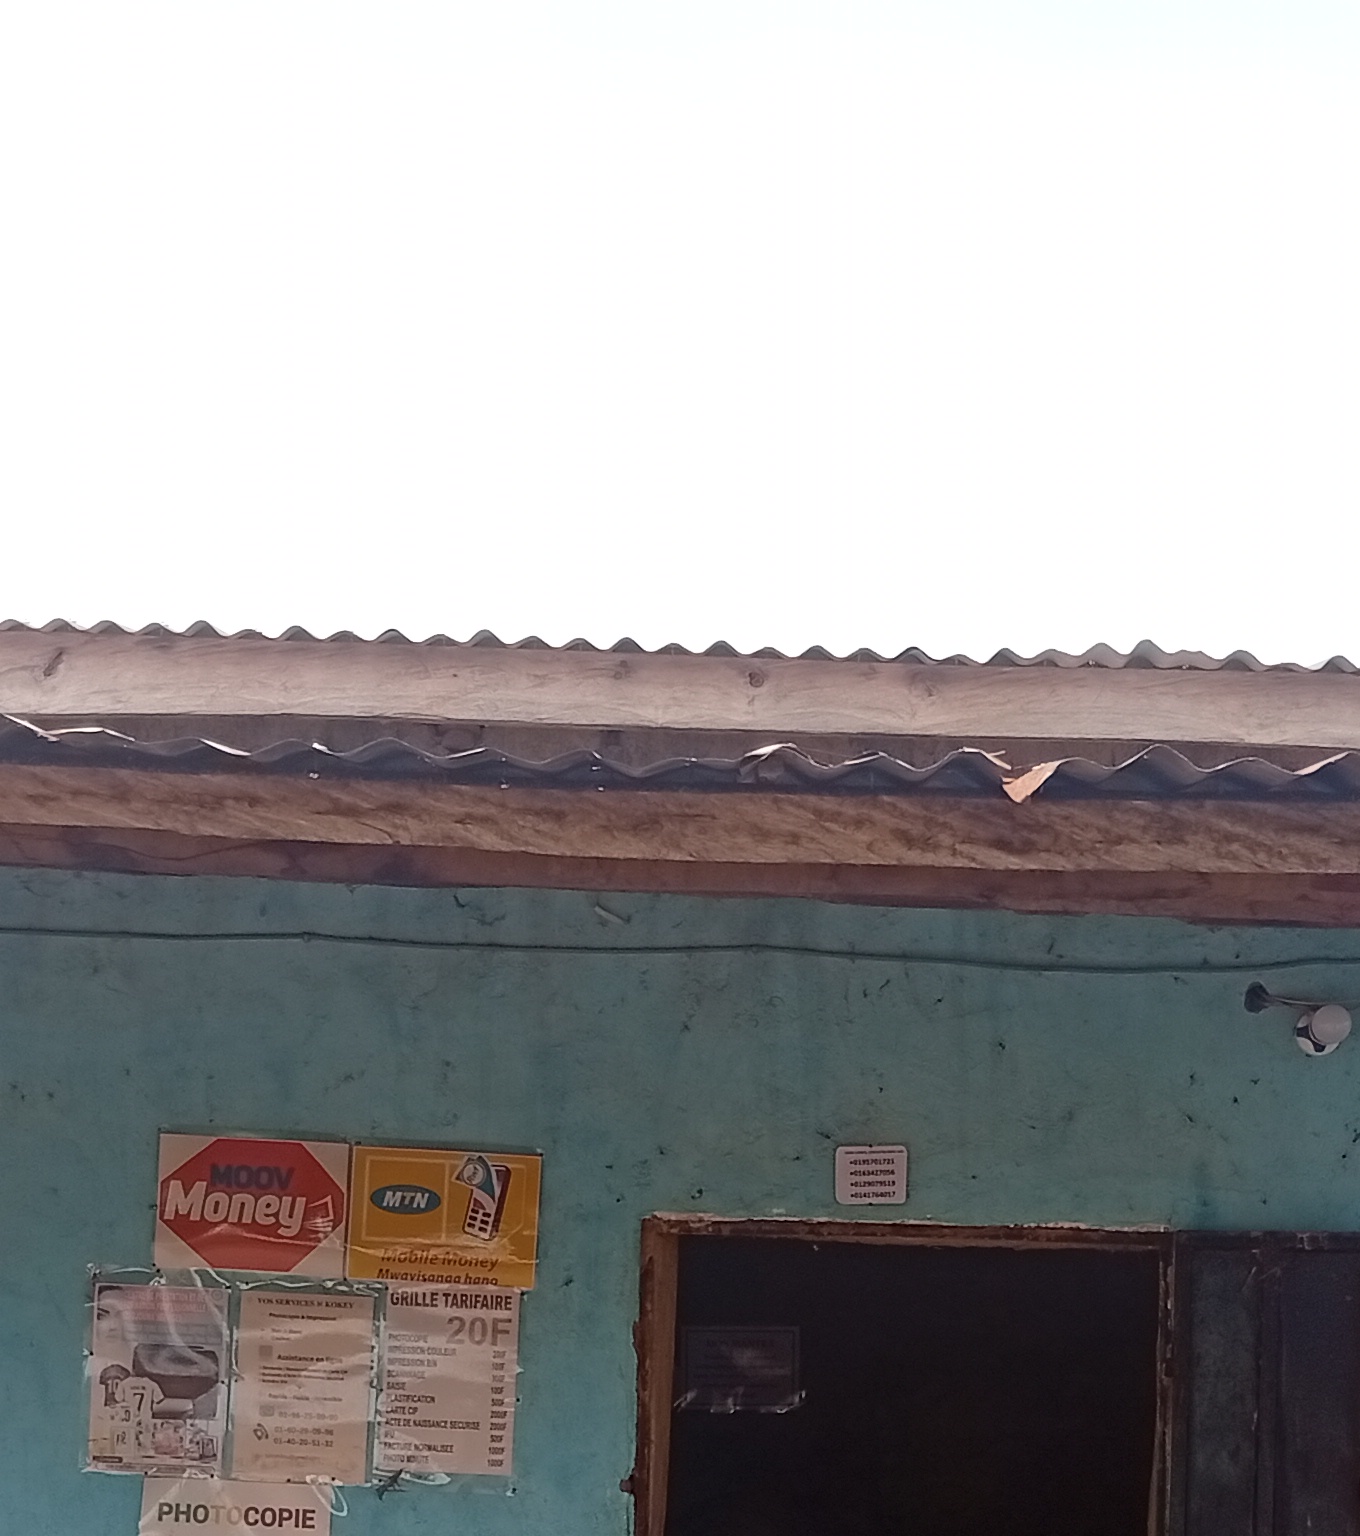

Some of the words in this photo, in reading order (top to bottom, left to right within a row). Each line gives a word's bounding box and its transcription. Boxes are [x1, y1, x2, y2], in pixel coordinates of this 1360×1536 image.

[210, 1163, 295, 1191] MOOV
[164, 1179, 307, 1238] Money
[382, 1190, 431, 1210] MTN
[381, 1248, 439, 1266] Mobile
[441, 1251, 499, 1272] Money
[275, 1298, 316, 1307] SERVICES
[390, 1291, 439, 1308] GRILLE
[442, 1293, 513, 1311] TARIFAIRE
[388, 1333, 428, 1343] PHOTOCOPIE
[445, 1315, 513, 1347] 20F
[426, 1347, 457, 1357] COULEUR
[403, 1419, 411, 1428] DE
[157, 1502, 317, 1529] PHOTOCOPIE
